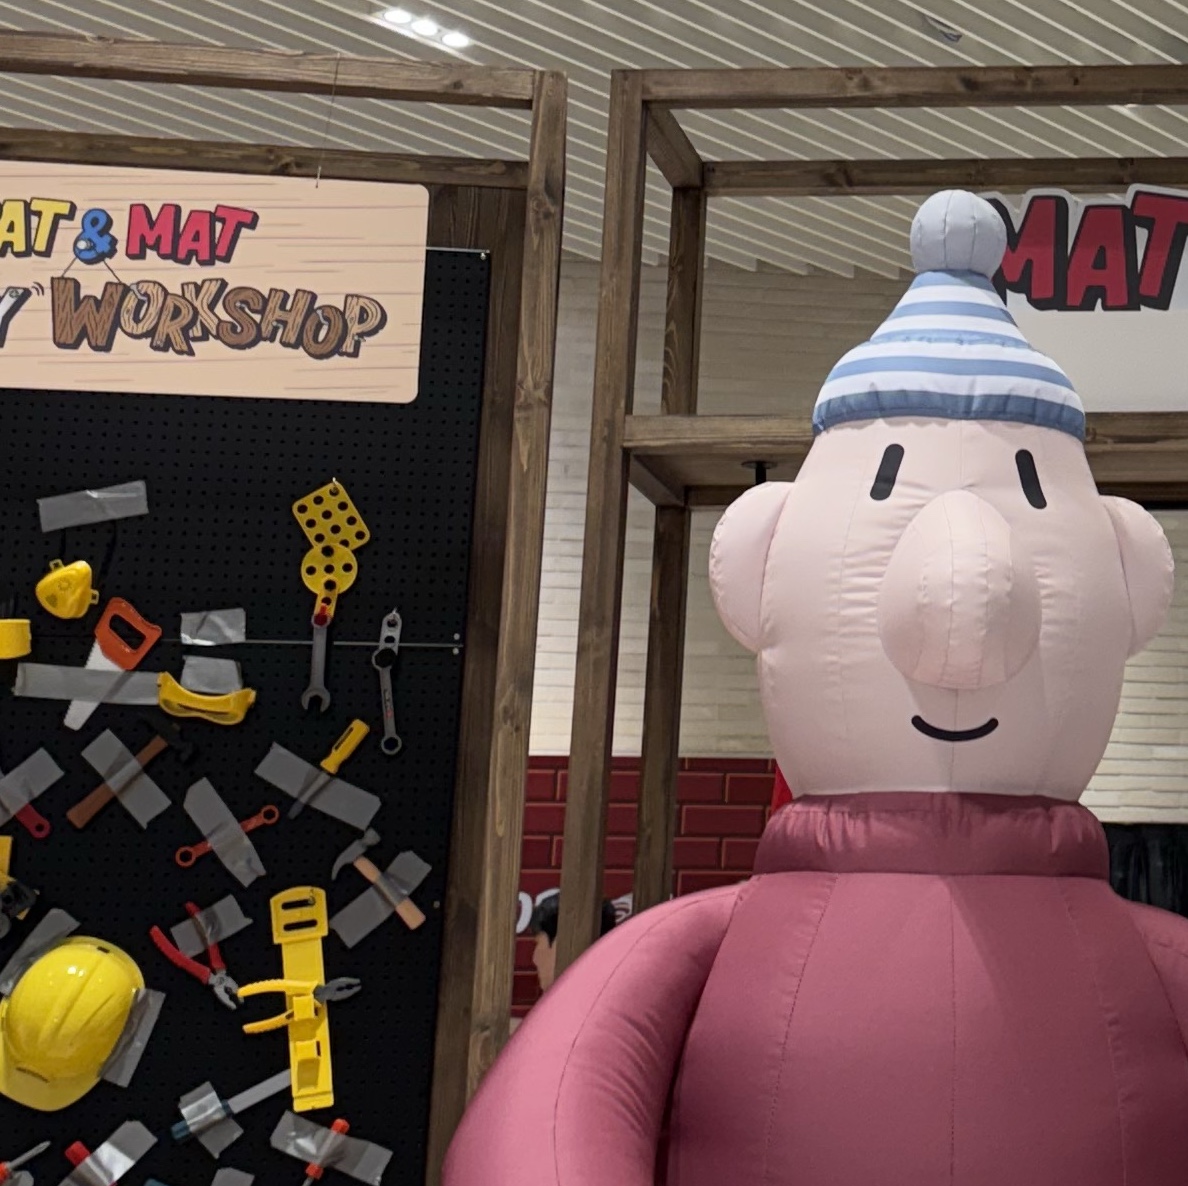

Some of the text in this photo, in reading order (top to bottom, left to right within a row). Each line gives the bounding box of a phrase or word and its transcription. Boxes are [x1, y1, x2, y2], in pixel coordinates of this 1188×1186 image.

[73, 208, 118, 265] &
[126, 204, 258, 265] MAT
[51, 276, 387, 361] WORKSHOP
